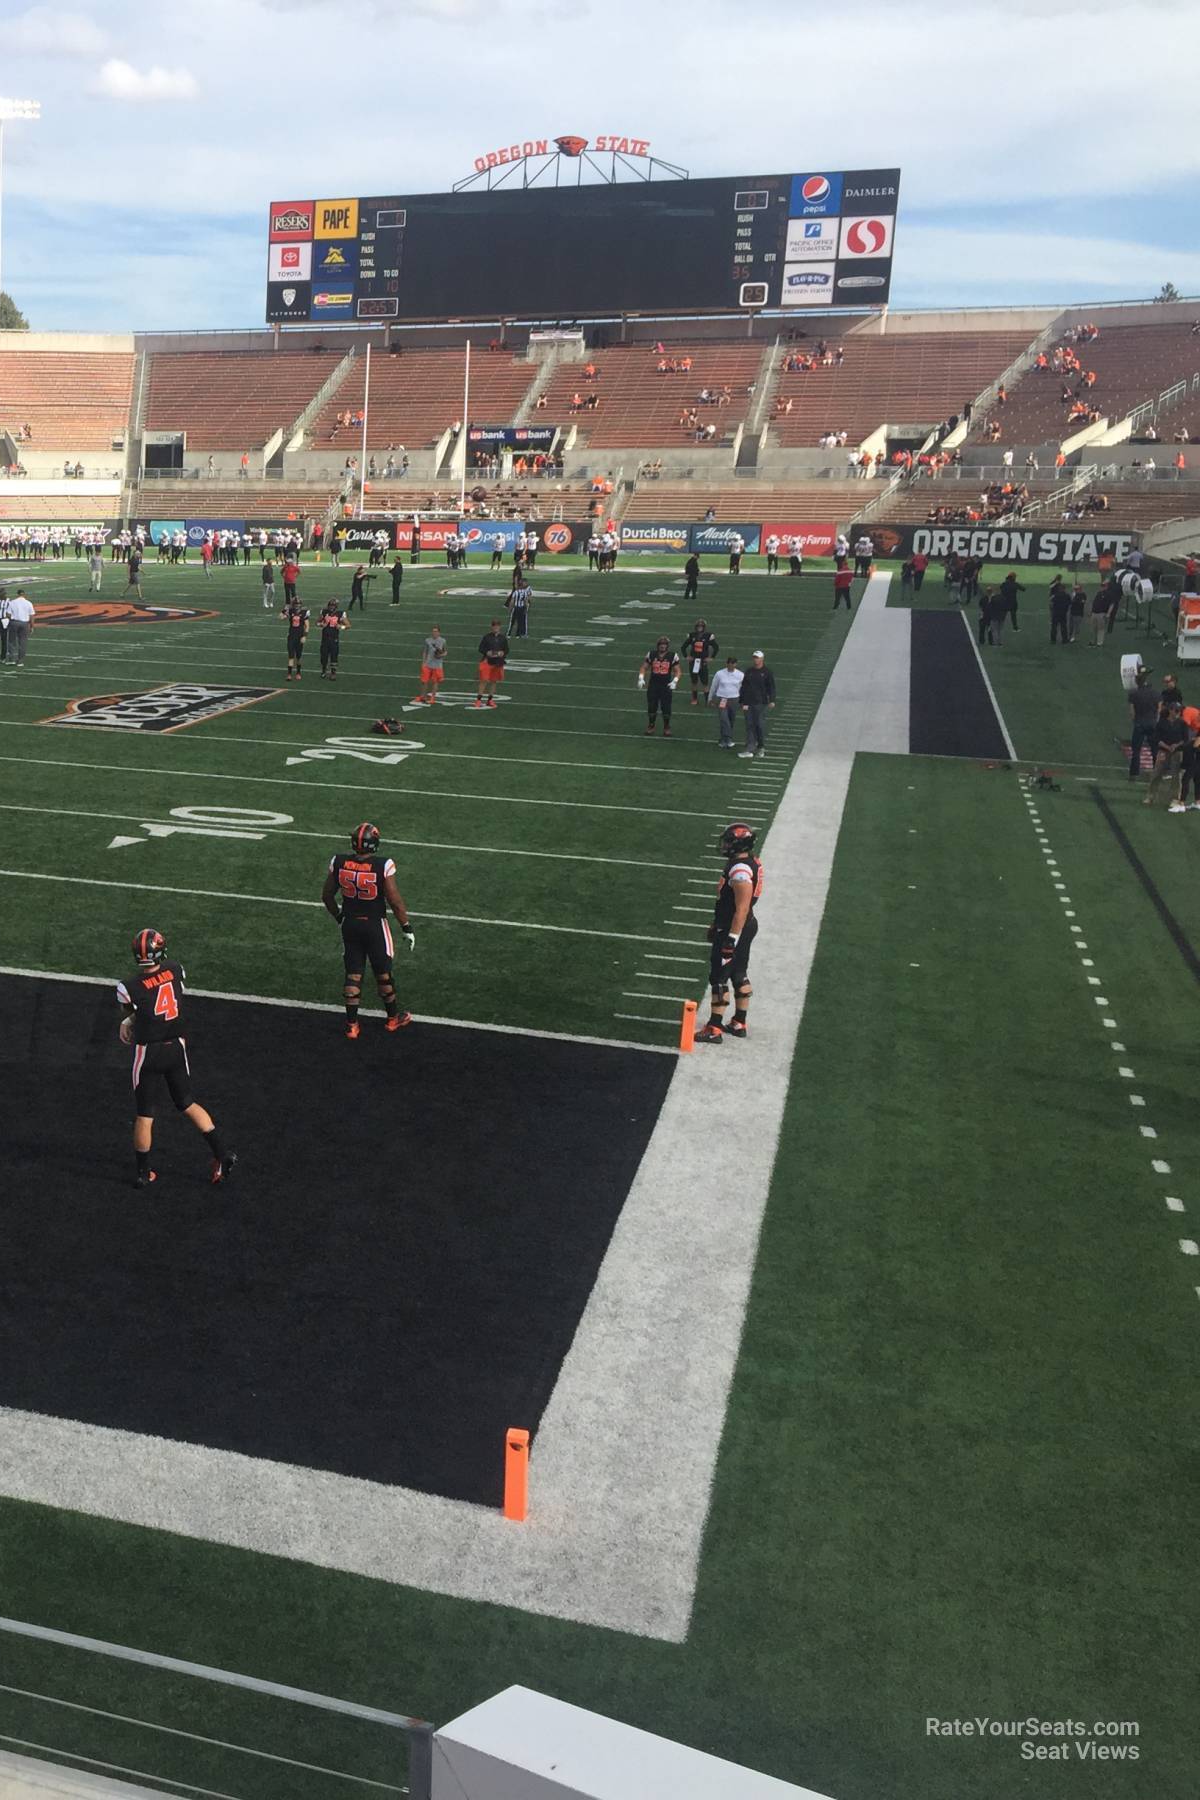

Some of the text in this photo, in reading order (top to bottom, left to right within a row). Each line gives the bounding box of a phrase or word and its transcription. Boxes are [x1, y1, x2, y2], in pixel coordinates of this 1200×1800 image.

[474, 136, 651, 172] OREGON STATE
[845, 187, 896, 198] DAIMLER
[803, 206, 826, 215] pepsi
[737, 228, 752, 237] PASS
[361, 246, 374, 254] PASS
[735, 242, 752, 251] TOTAL
[360, 259, 375, 267] TOTAL
[278, 270, 302, 278] TOYOTA
[549, 531, 568, 544] 76
[696, 527, 737, 540] Alaska
[806, 535, 831, 545] Farm
[912, 529, 1132, 563] OREGON STATE
[301, 737, 425, 765] 20
[139, 806, 294, 840] 10
[339, 868, 377, 900] 55
[154, 981, 178, 1021] 4
